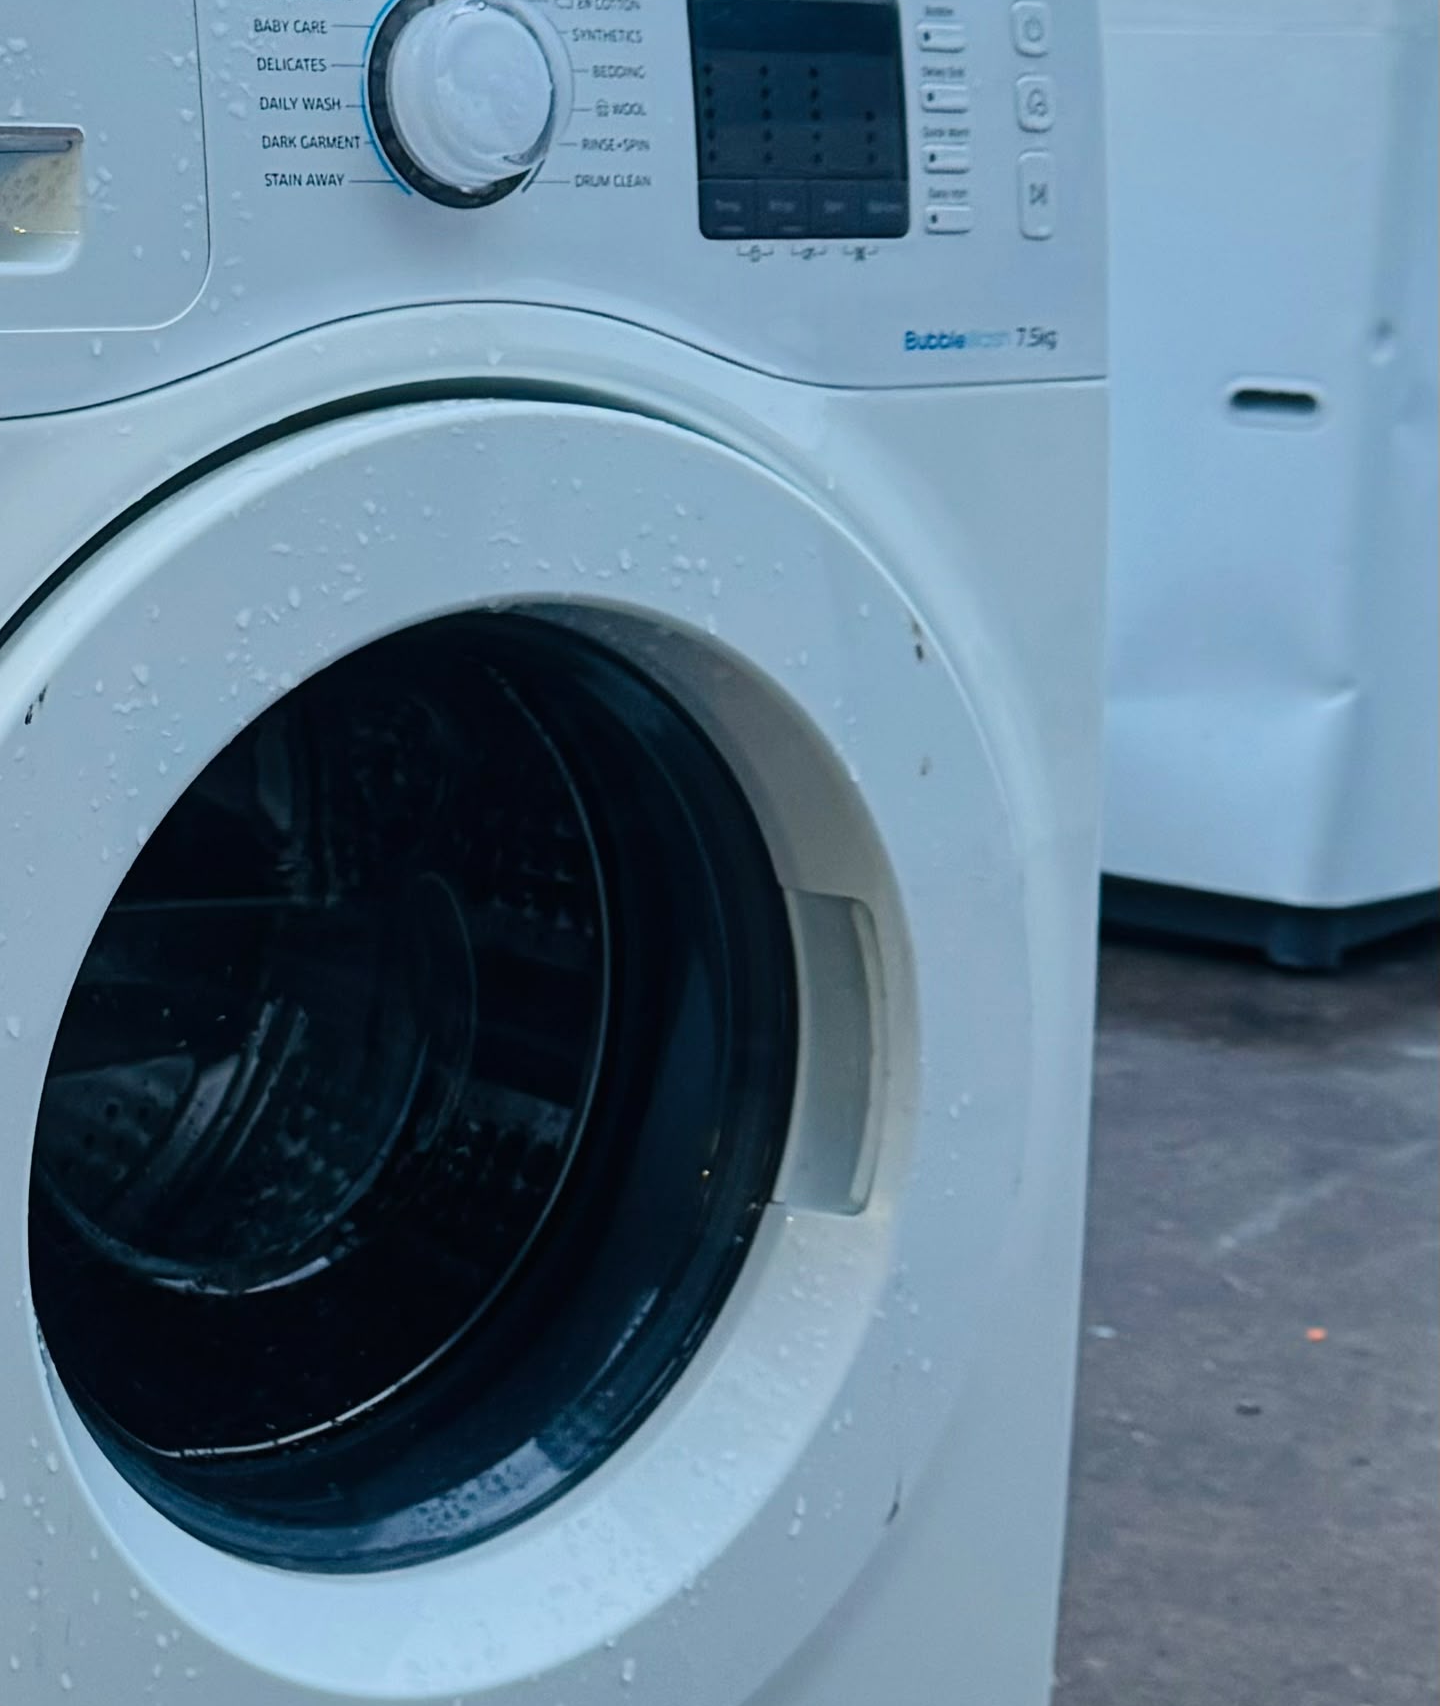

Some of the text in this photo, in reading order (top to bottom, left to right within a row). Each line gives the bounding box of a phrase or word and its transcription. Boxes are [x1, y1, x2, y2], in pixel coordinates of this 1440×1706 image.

[254, 18, 327, 34] BABY CARE
[572, 28, 643, 43] SYNTHETICS
[257, 57, 327, 72] DELICATES
[592, 65, 646, 79] BEDDING
[260, 96, 341, 111] DAILY WASH
[612, 102, 647, 116] WOOL
[262, 135, 360, 150] DARK GARMENT
[264, 173, 344, 187] STAIN AWAY
[575, 174, 652, 188] DRUM CLEAN
